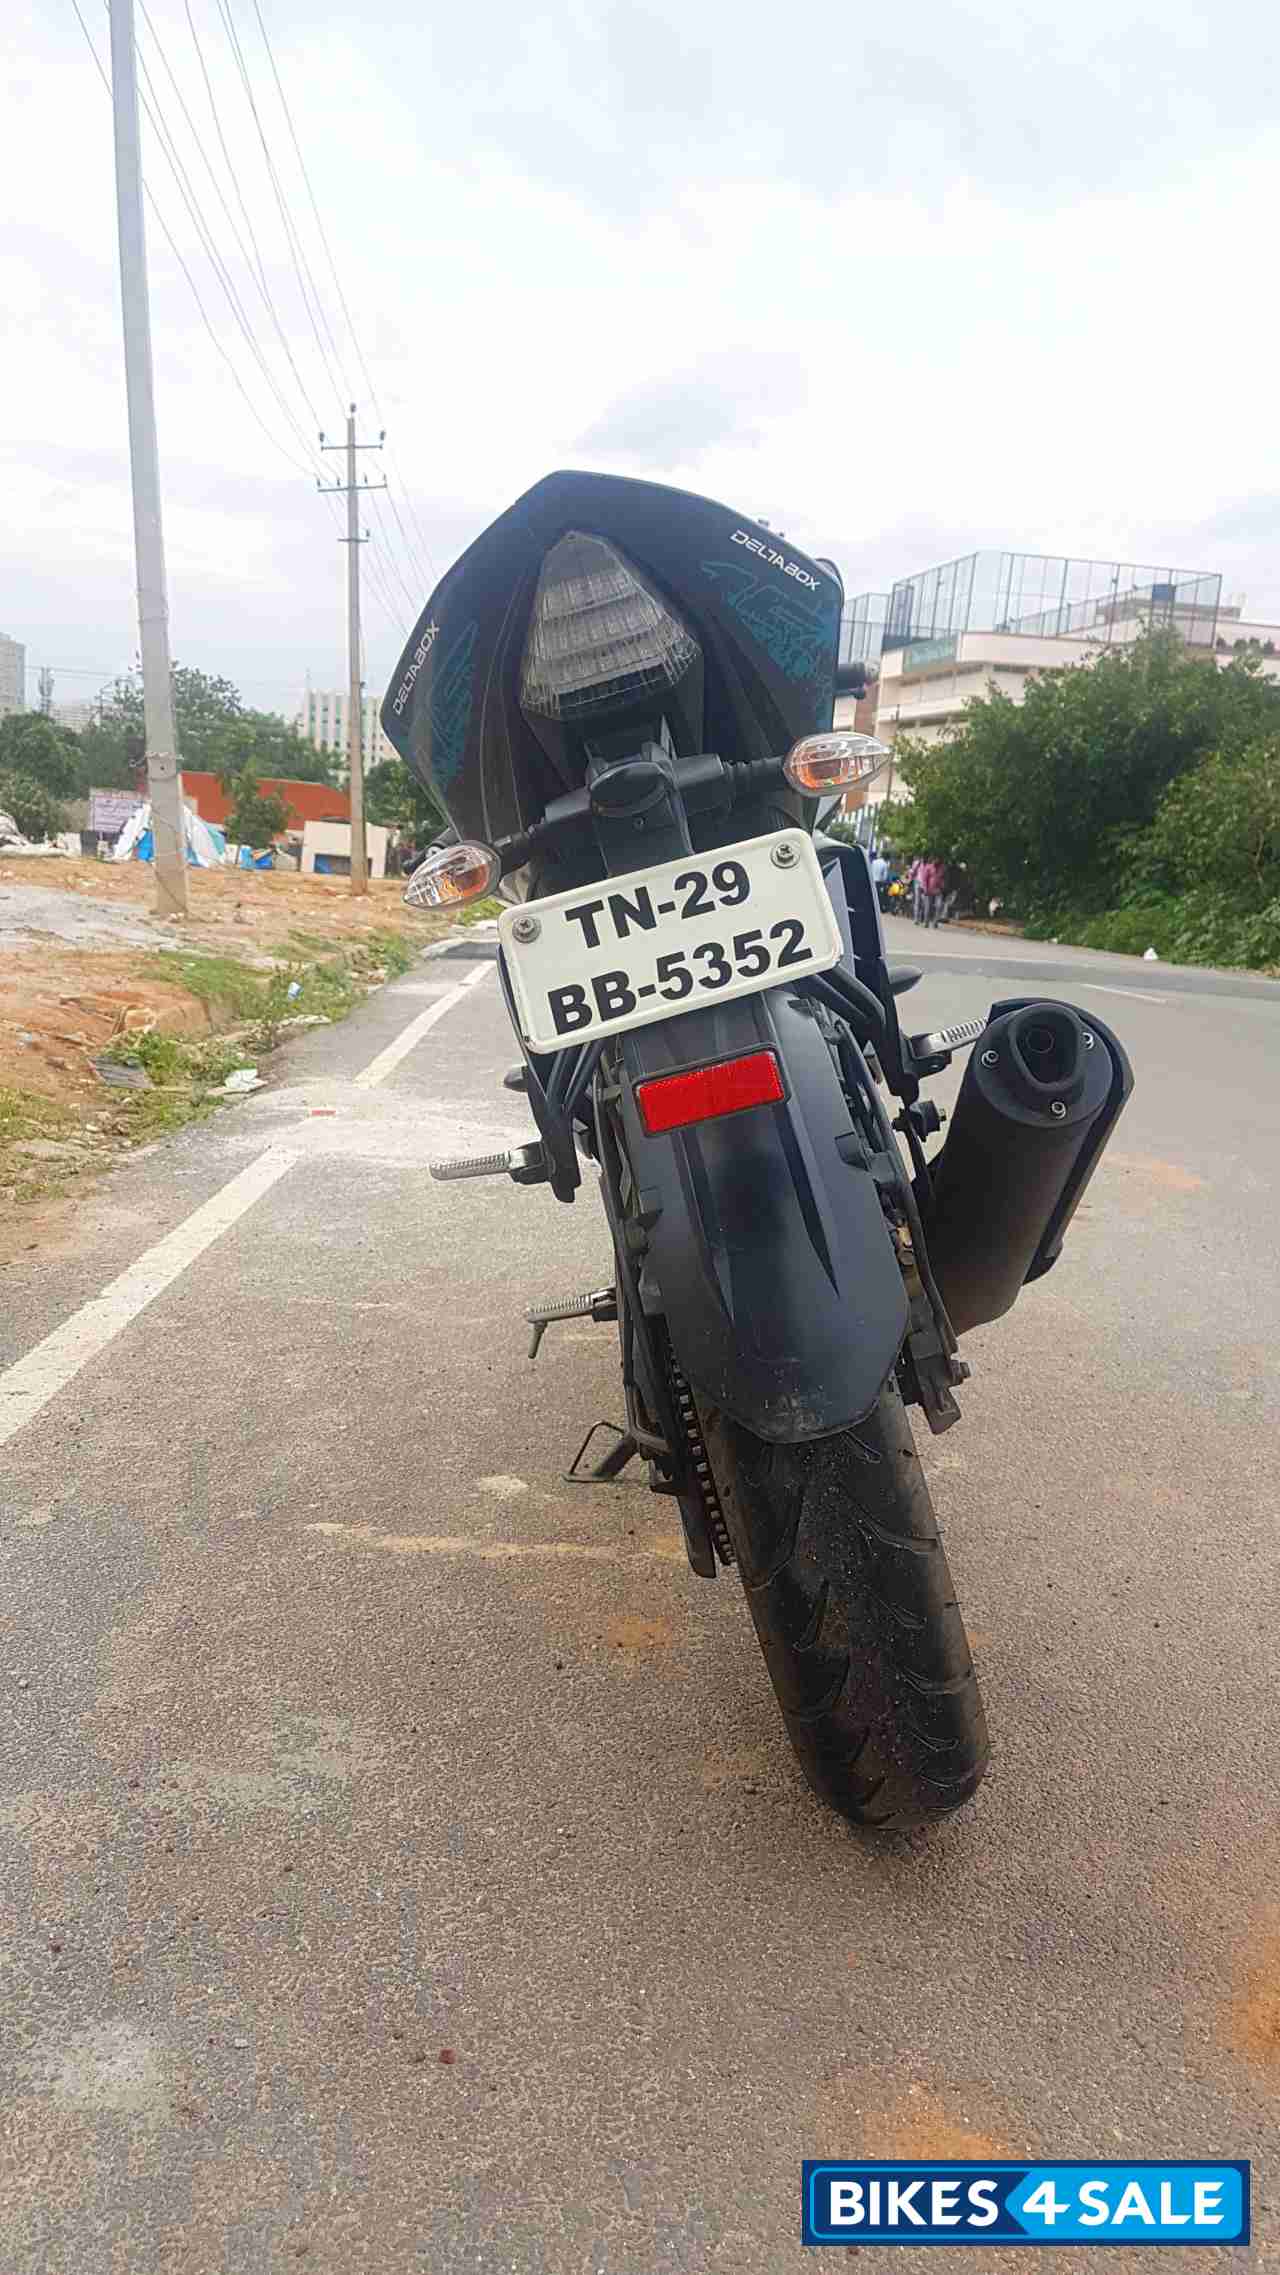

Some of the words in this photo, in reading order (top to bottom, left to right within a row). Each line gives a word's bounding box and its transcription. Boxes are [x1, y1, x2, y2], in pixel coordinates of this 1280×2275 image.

[729, 529, 821, 591] DELTABOX
[393, 619, 440, 715] DELTABOX
[565, 860, 751, 949] TN-29
[547, 919, 813, 1036] BB-5352
